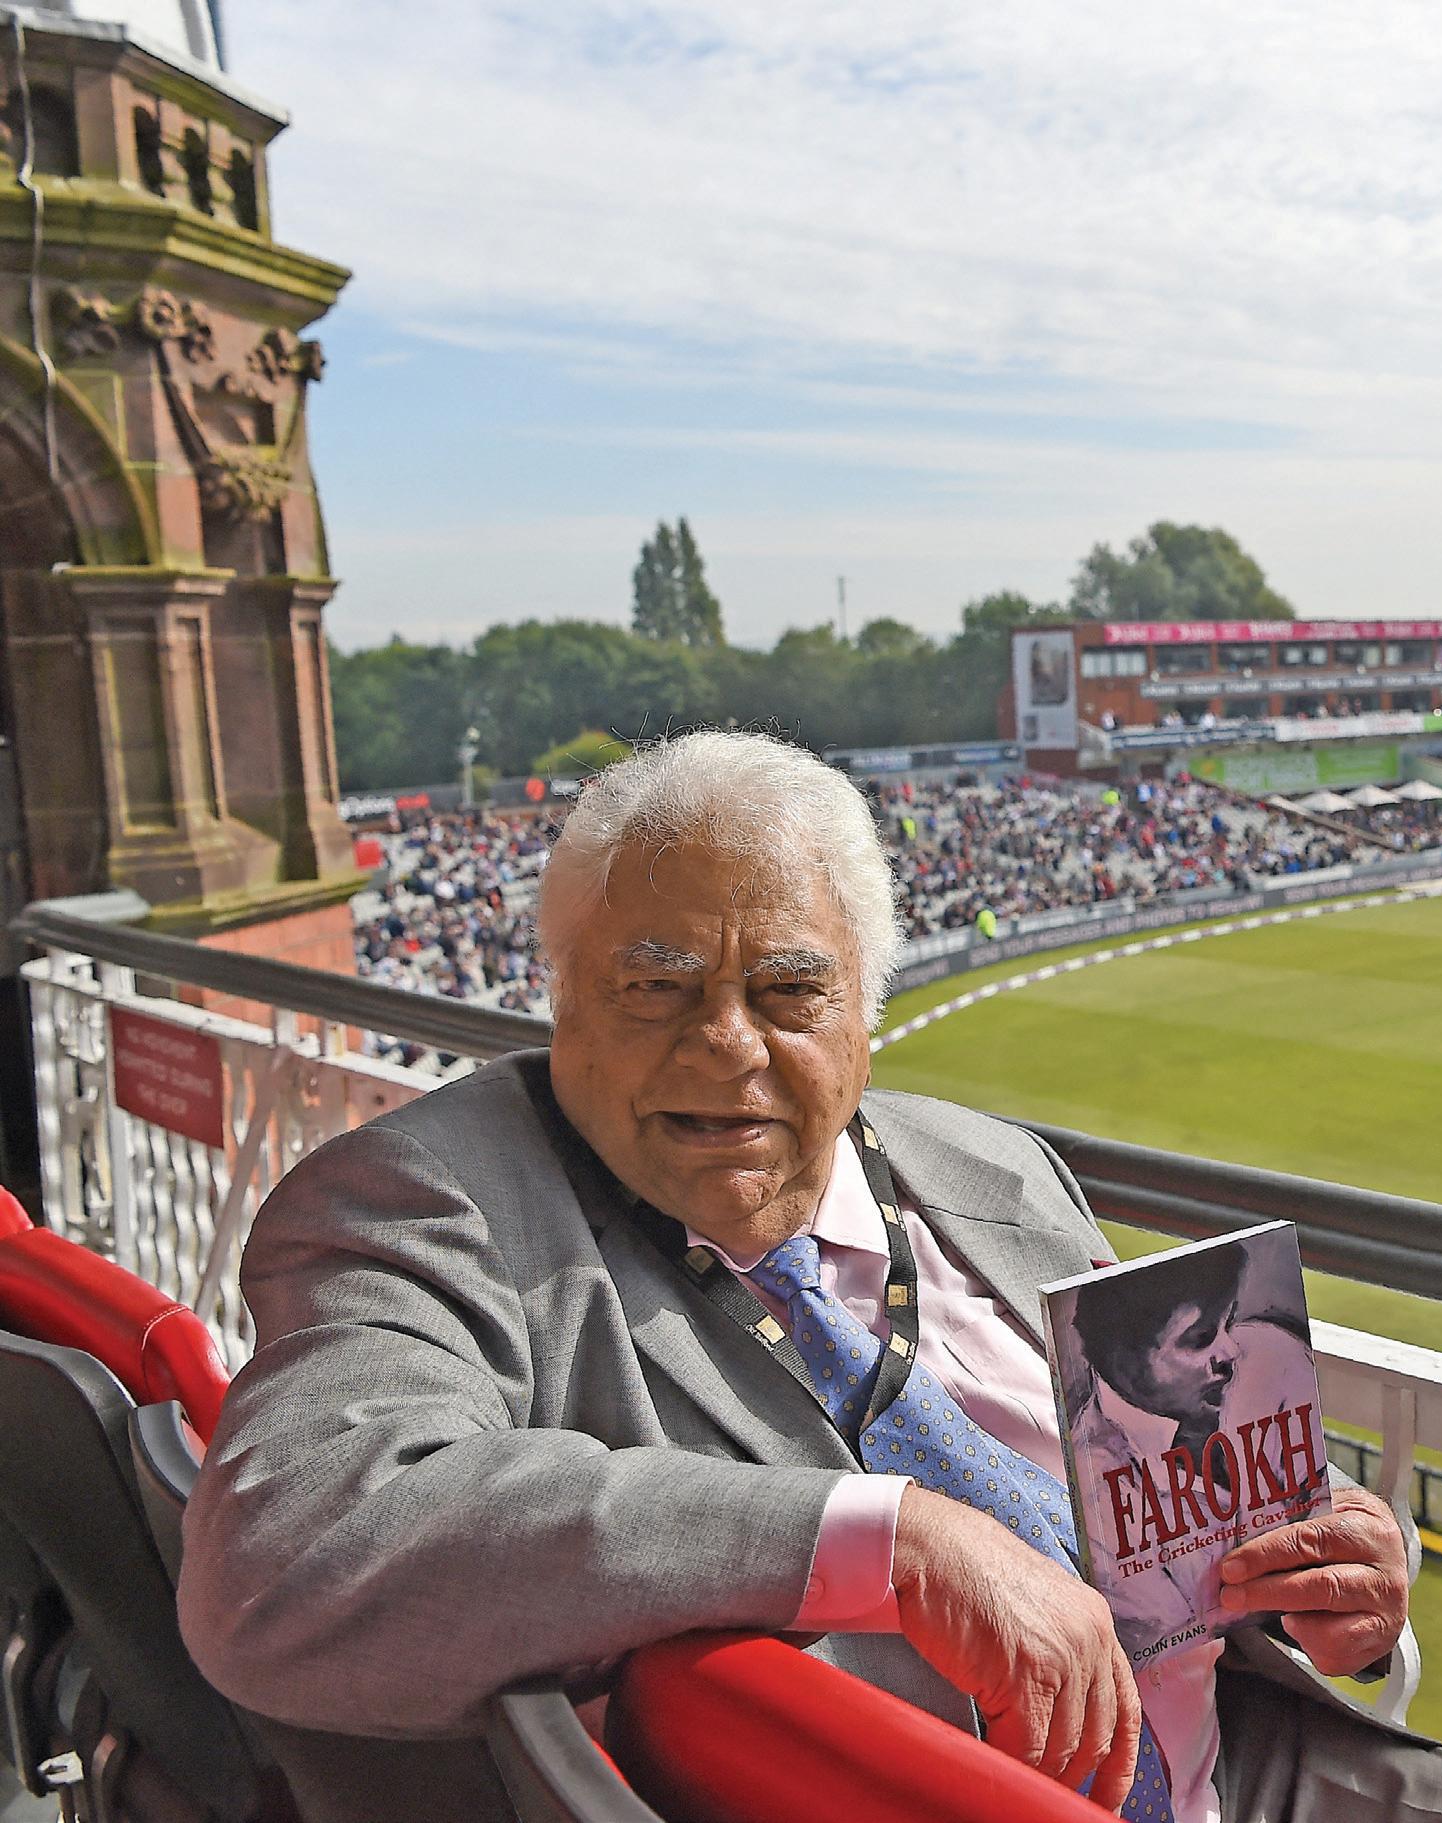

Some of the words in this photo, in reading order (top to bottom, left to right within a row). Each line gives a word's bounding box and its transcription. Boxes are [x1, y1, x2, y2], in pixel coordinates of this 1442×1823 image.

[1103, 1403, 1322, 1560] FAROKH
[1118, 1560, 1153, 1579] The
[1158, 1523, 1248, 1565] Cricketing
[1133, 1639, 1168, 1662] COLIN
[1171, 1624, 1207, 1647] EVANS
